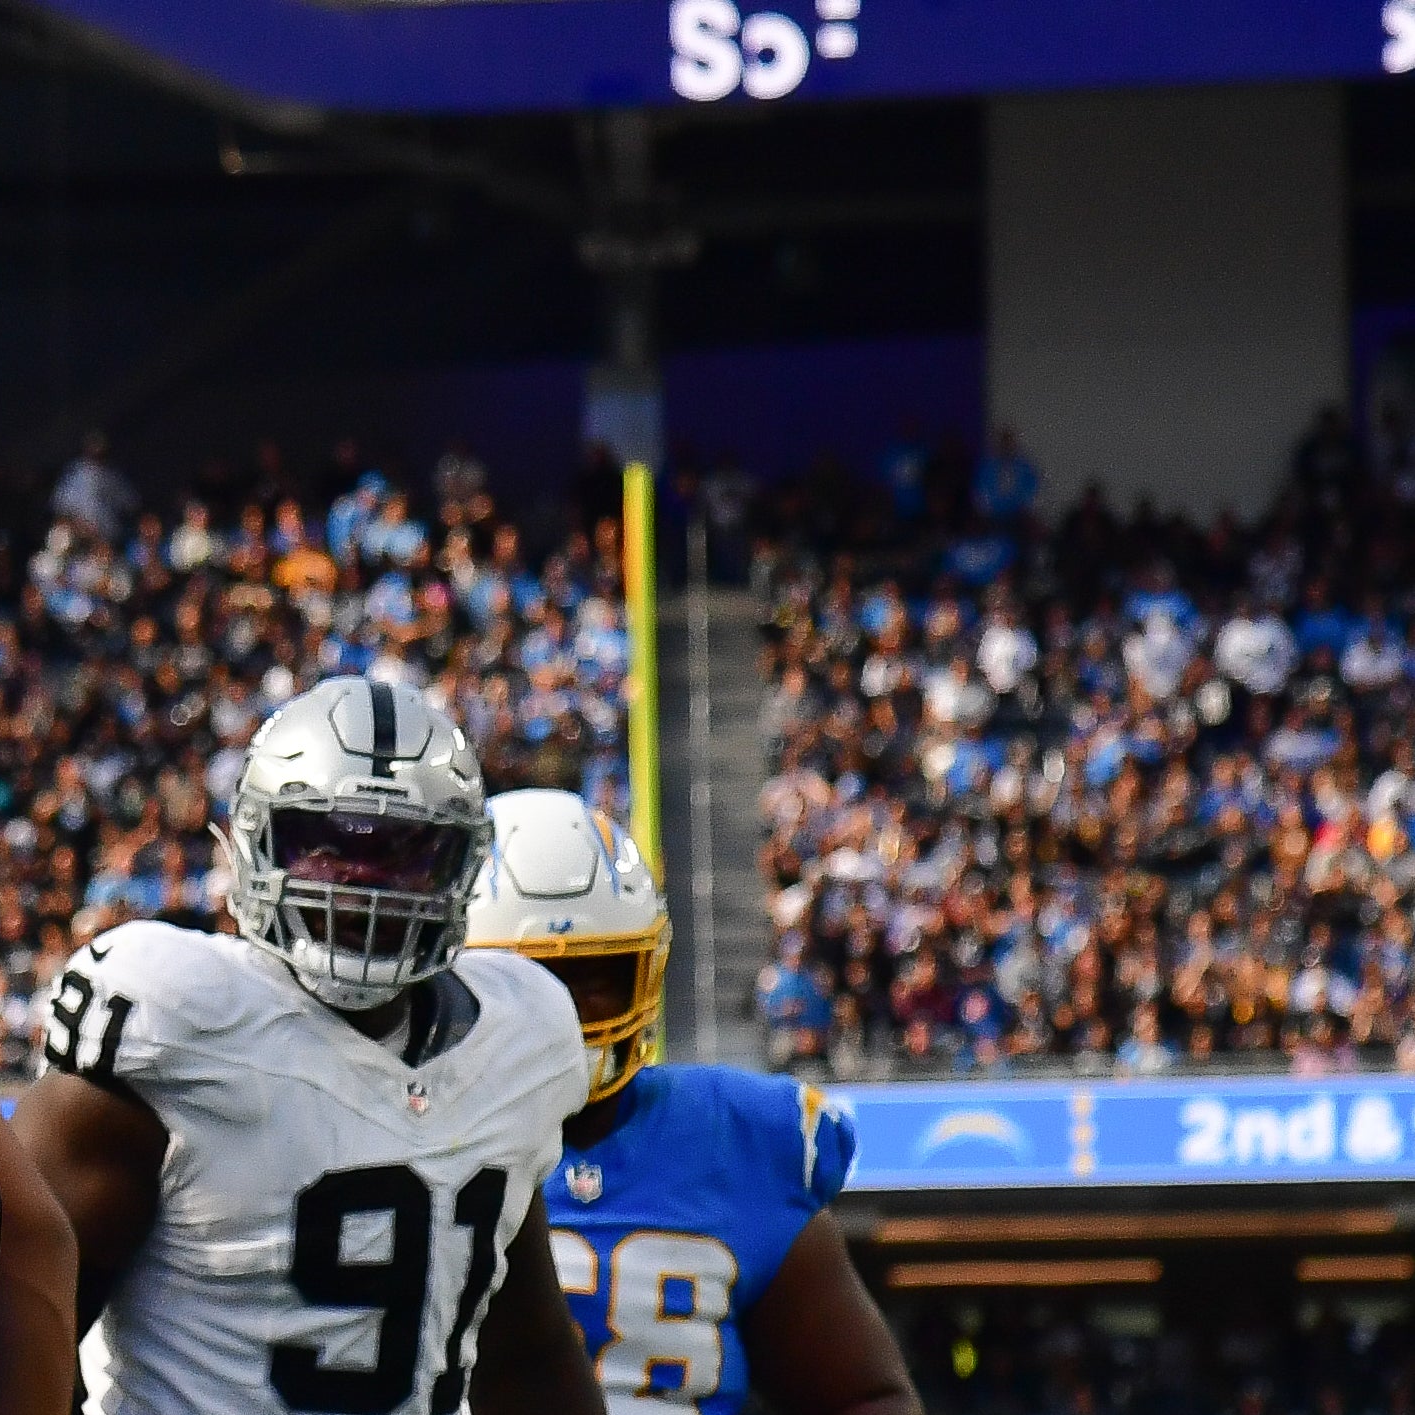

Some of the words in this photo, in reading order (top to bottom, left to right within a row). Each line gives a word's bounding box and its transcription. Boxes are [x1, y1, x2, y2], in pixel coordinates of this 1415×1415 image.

[44, 967, 134, 1078] 91
[1179, 1098, 1335, 1162] 2nd
[1346, 1096, 1402, 1162] &
